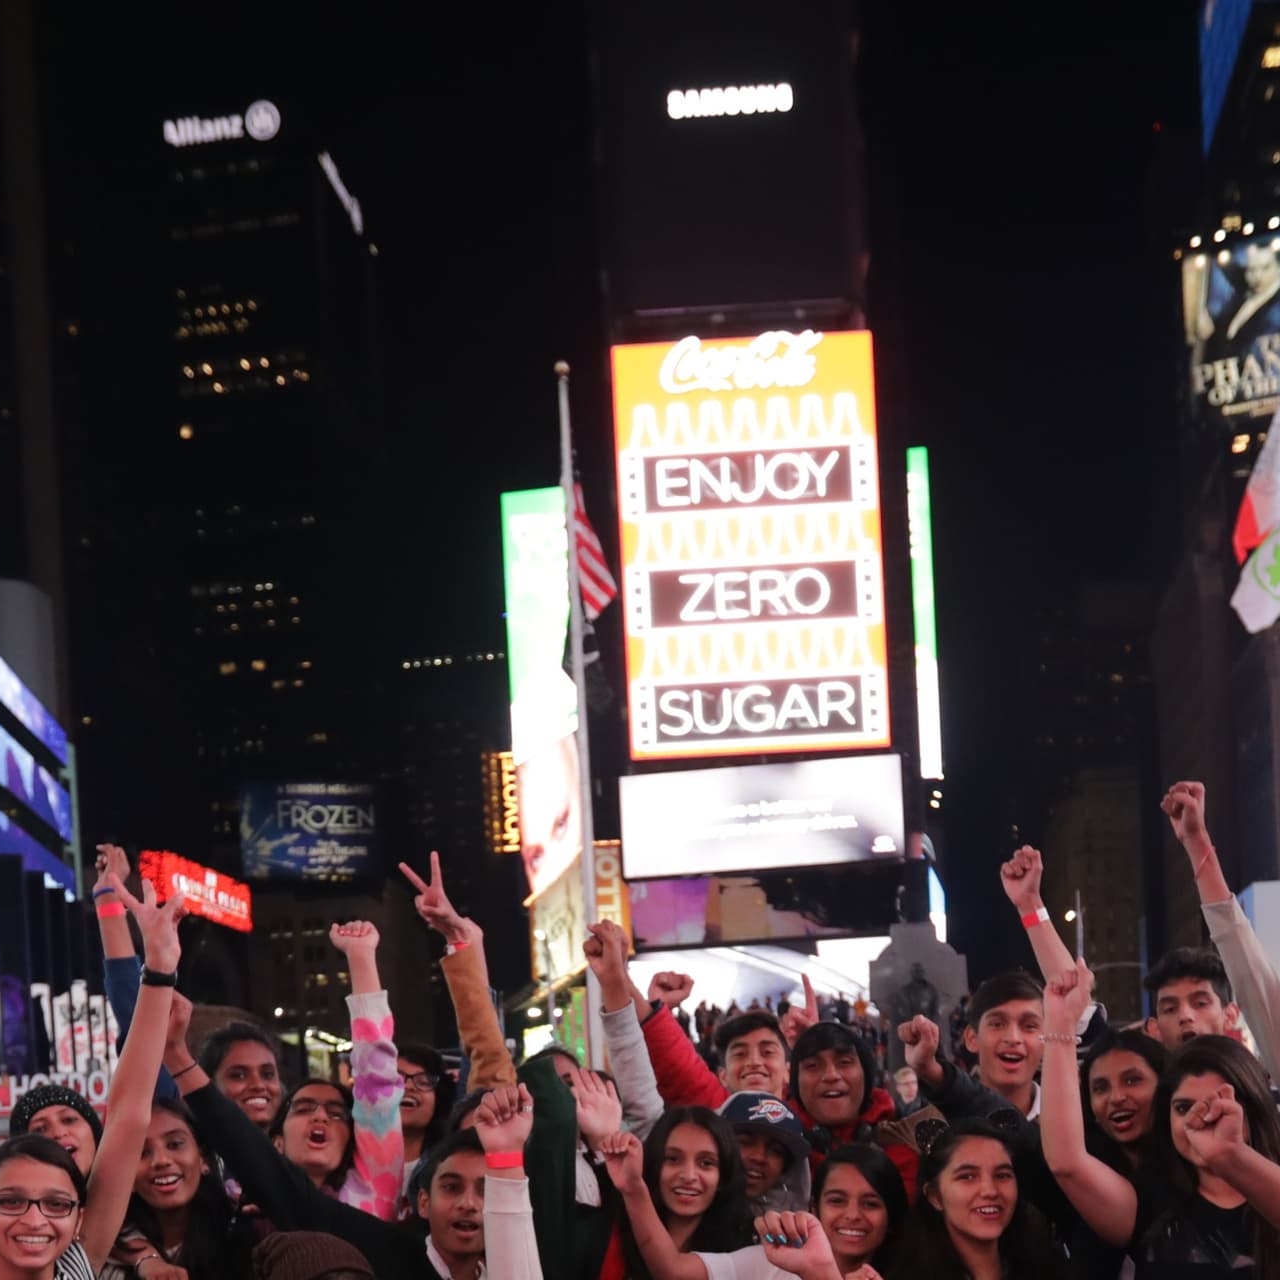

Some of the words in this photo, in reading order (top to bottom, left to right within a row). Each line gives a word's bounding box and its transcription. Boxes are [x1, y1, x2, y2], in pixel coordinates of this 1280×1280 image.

[163, 114, 245, 148] Allianz
[653, 450, 840, 507] ENJOY
[678, 566, 831, 622] ZERO
[659, 680, 857, 739] SUGAR
[276, 800, 376, 834] FROZEN
